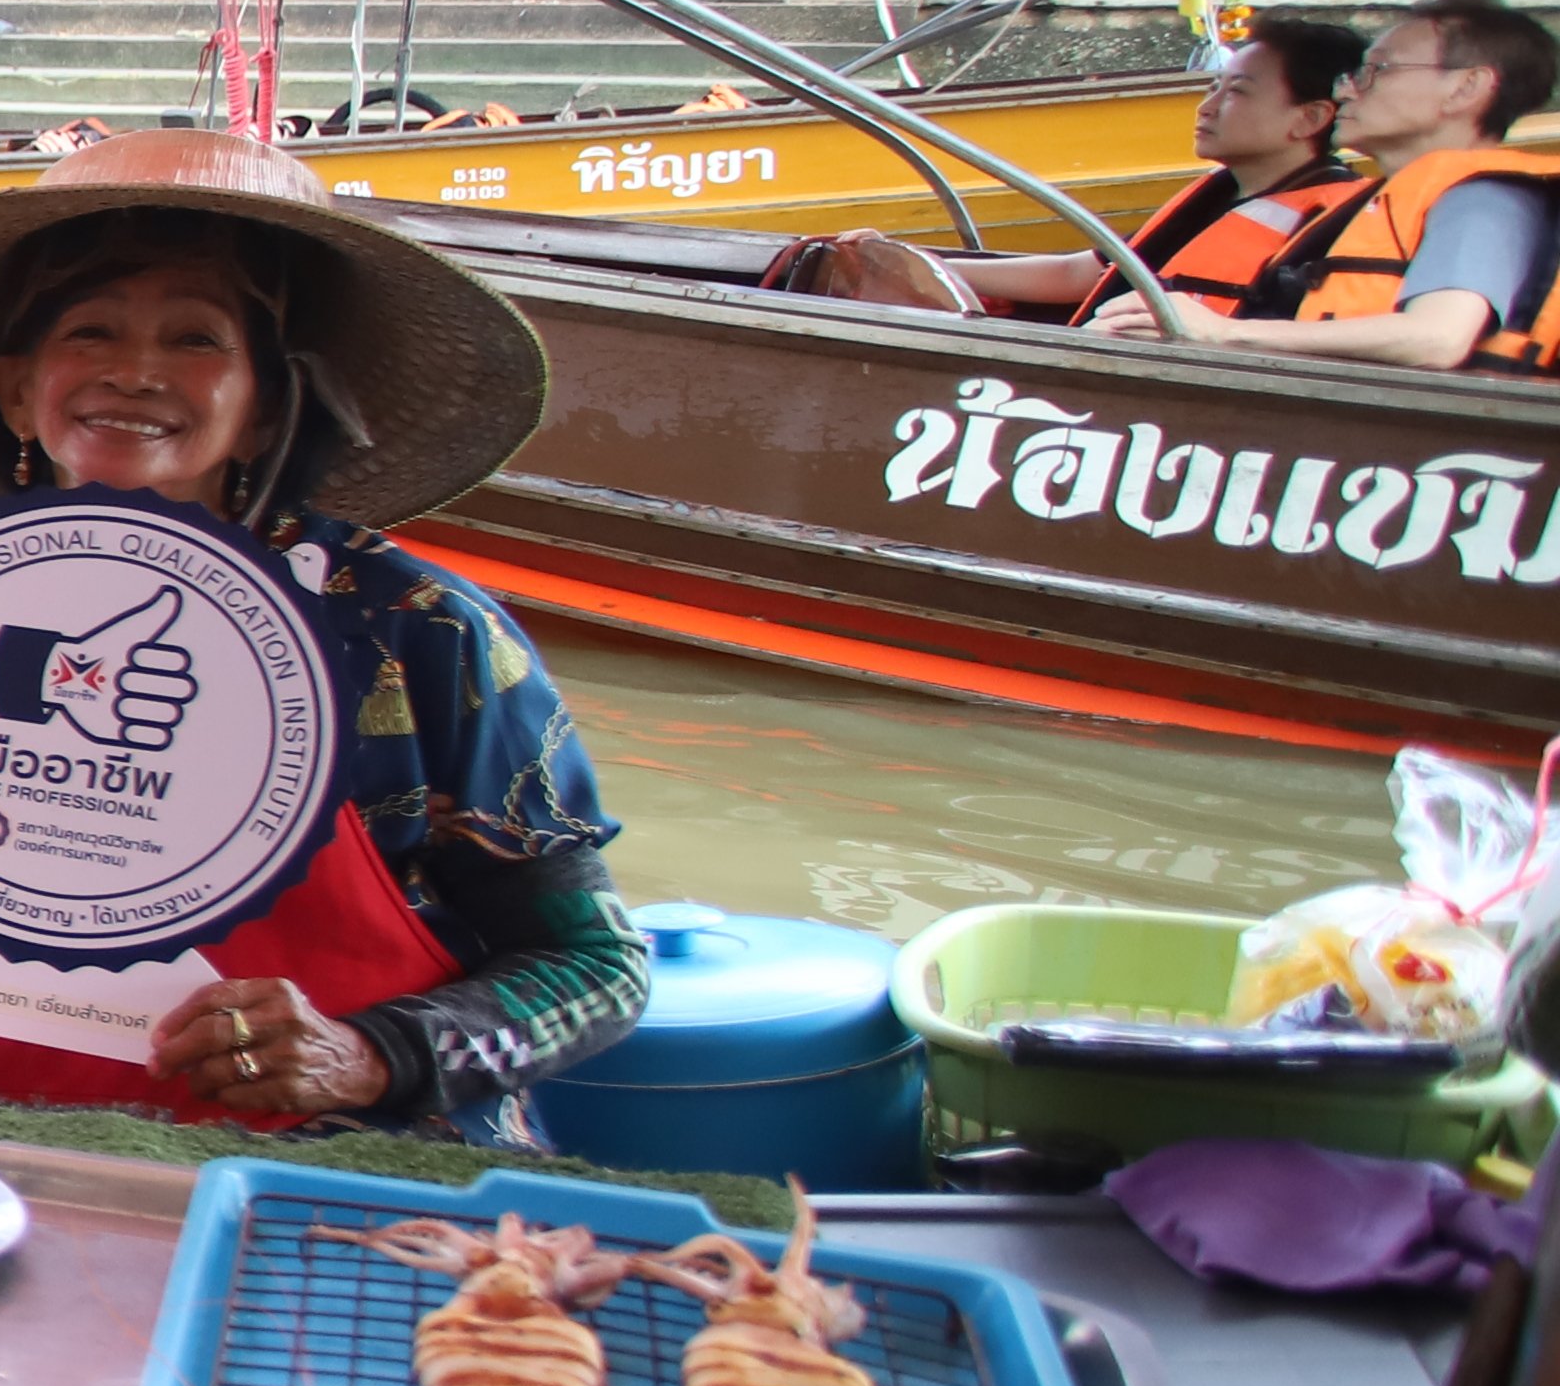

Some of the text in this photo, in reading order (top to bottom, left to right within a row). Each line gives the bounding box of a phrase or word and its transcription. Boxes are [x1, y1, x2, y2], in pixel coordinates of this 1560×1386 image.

[451, 166, 506, 183] 5130
[570, 139, 777, 199] หิรัญยา
[439, 184, 507, 202] 80103
[120, 532, 299, 683] QUALIFICATION
[247, 696, 309, 844] INSTITUTE
[6, 784, 158, 821] PROFESSIONAL
[14, 837, 128, 869] (องค์การมหาชน)
[17, 821, 164, 855] สถาบันคุณวุฒิวิชาชีพ
[90, 886, 203, 926] ได้มาตรฐาน
[35, 992, 152, 1031] เอี่ยมสำอางค์
